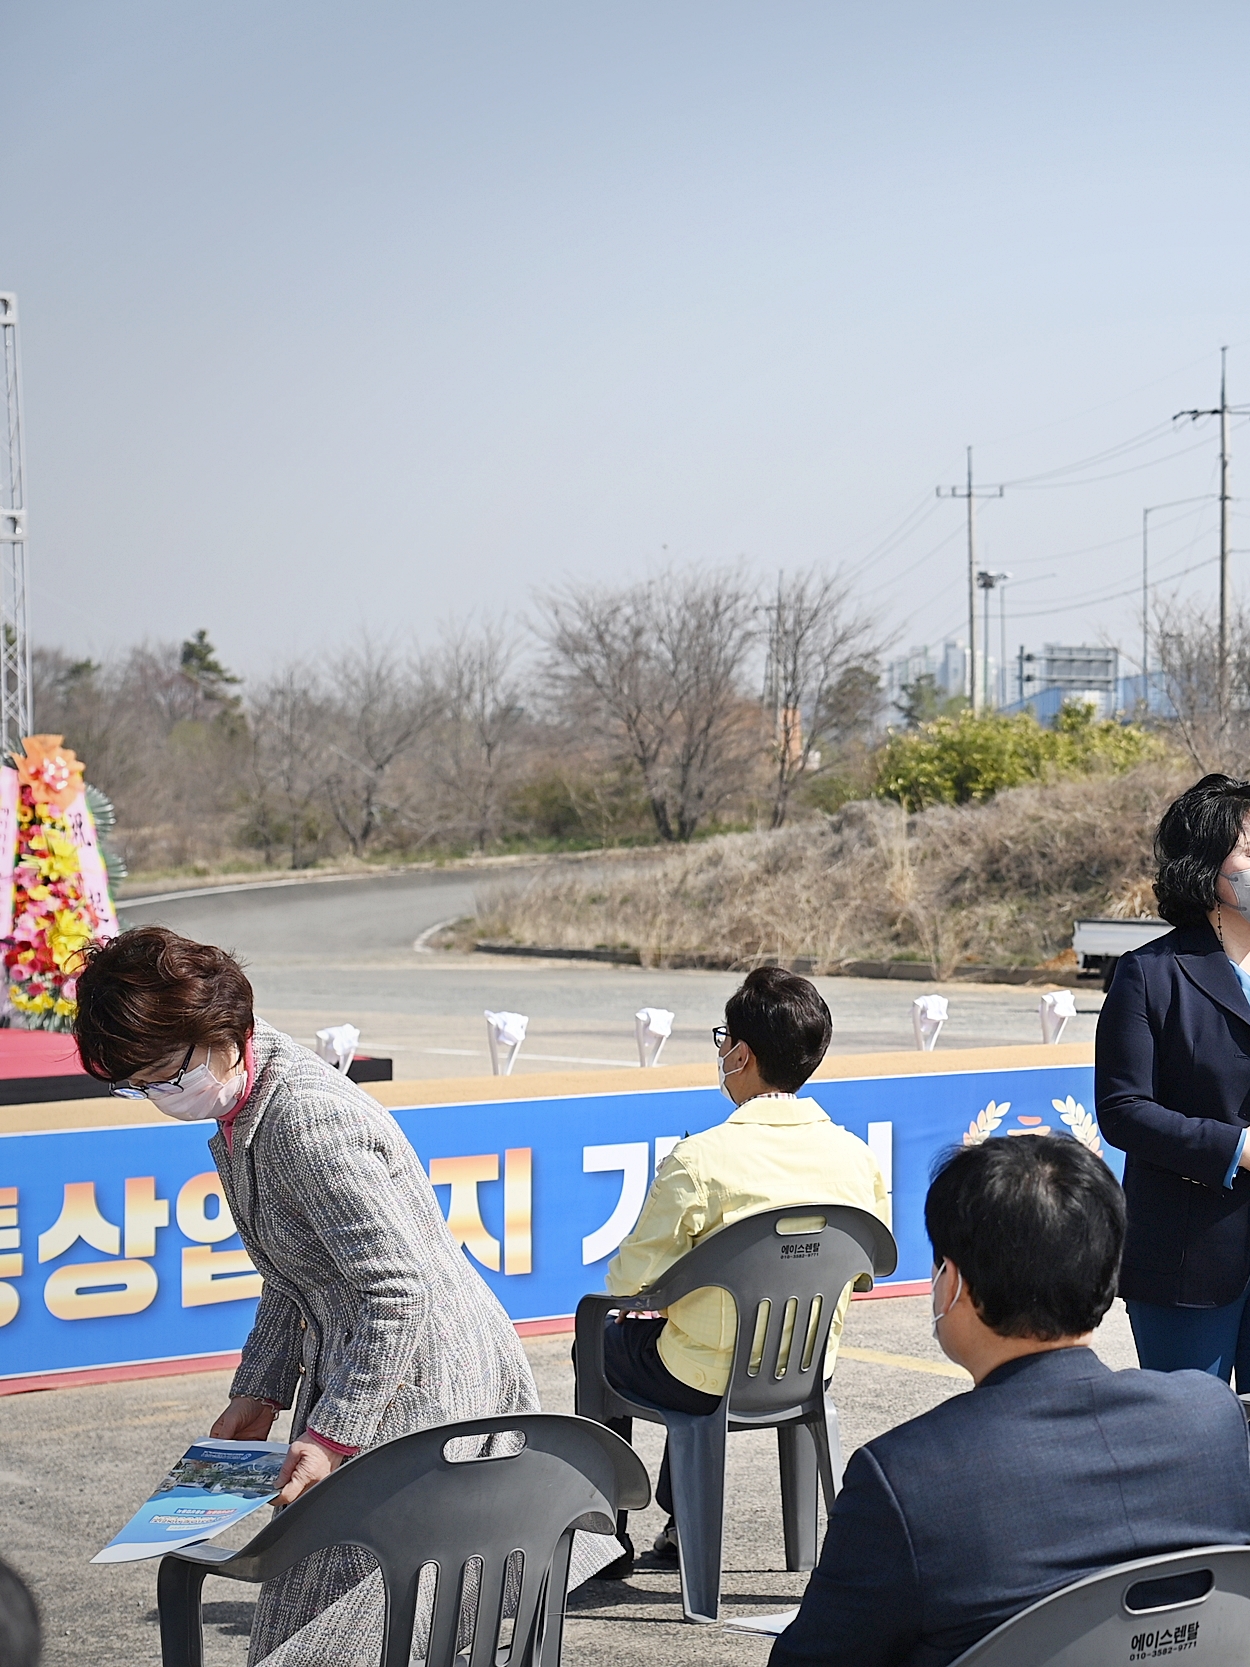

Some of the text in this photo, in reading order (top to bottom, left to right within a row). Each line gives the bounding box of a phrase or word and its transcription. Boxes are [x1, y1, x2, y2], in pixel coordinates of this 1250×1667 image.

[781, 1242, 820, 1254] 에이스렌탈
[1131, 1621, 1199, 1651] 에이스렌탈
[1129, 1641, 1197, 1661] 010-3582-9771
